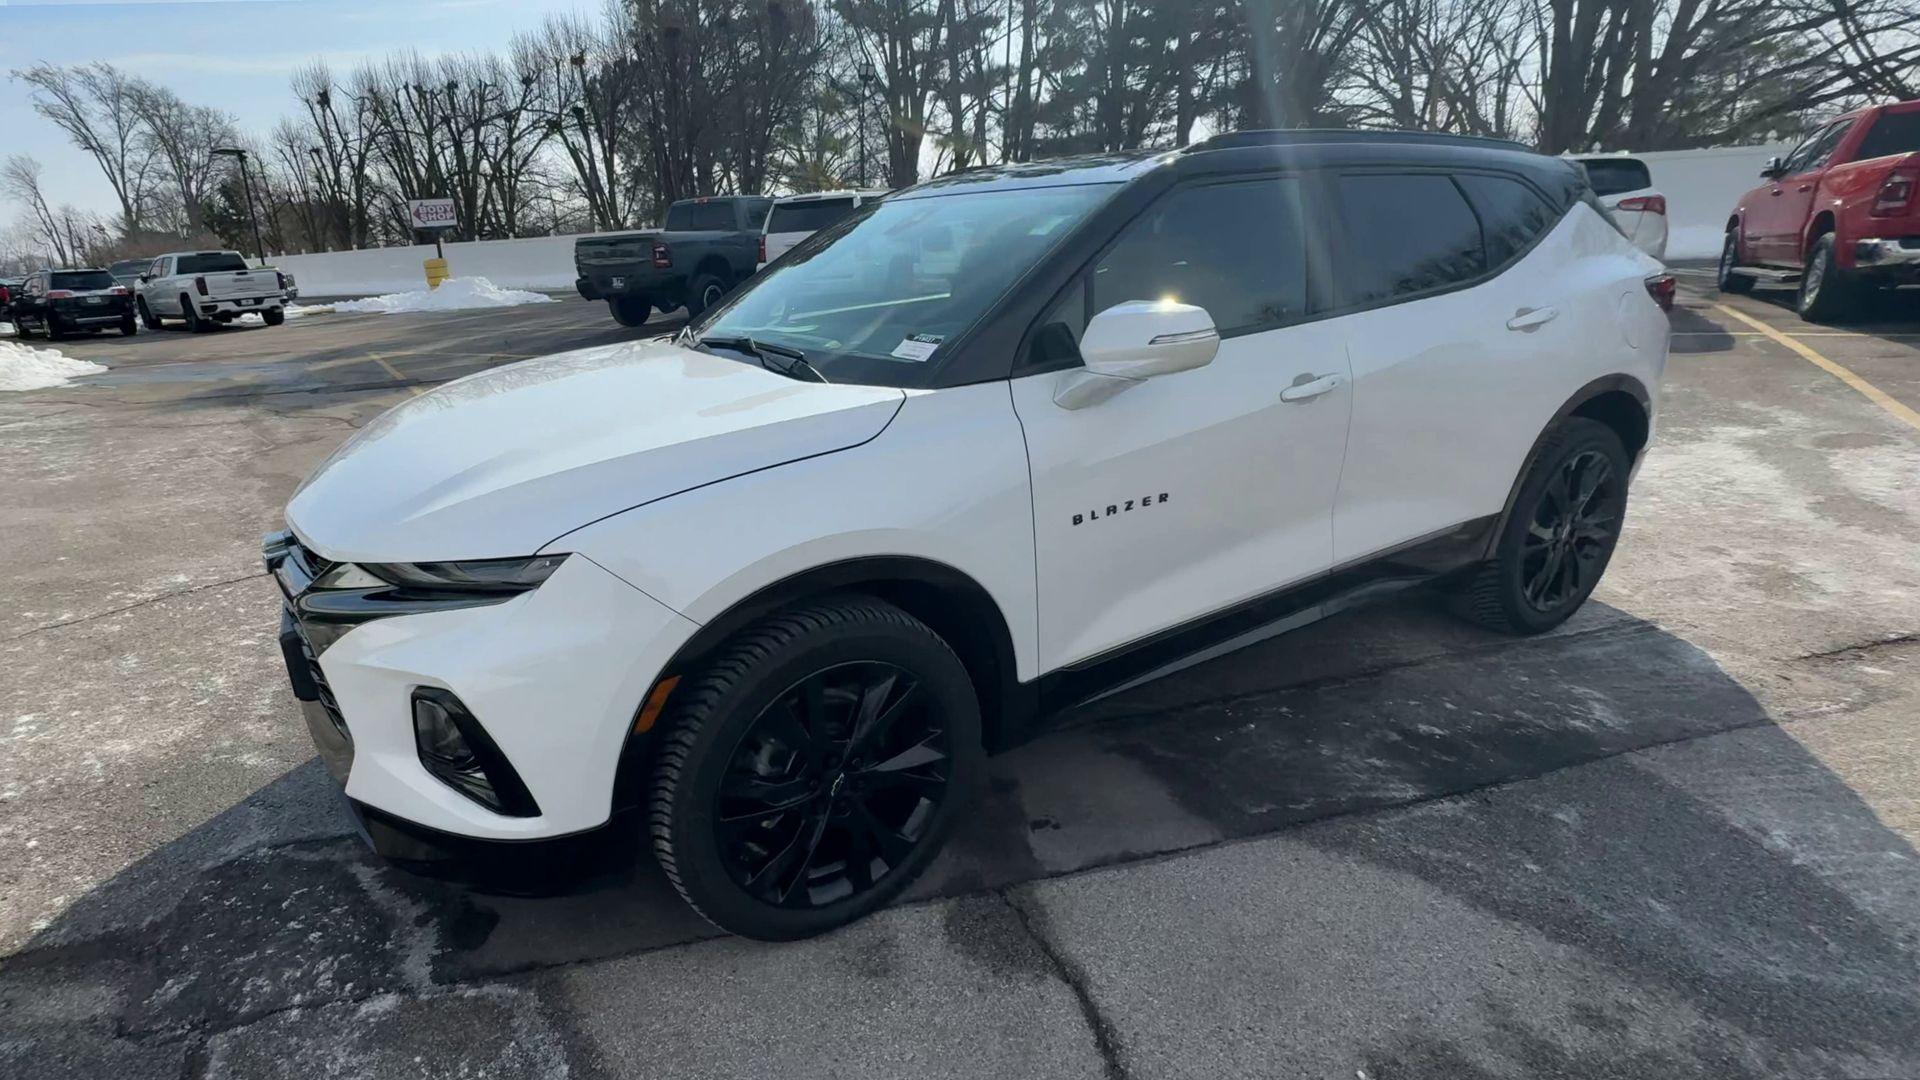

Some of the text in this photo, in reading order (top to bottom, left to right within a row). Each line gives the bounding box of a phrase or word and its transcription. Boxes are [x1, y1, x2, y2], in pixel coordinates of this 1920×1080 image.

[419, 204, 451, 213] BODY
[420, 212, 454, 221] SHOP
[1072, 493, 1169, 526] BLAZER
